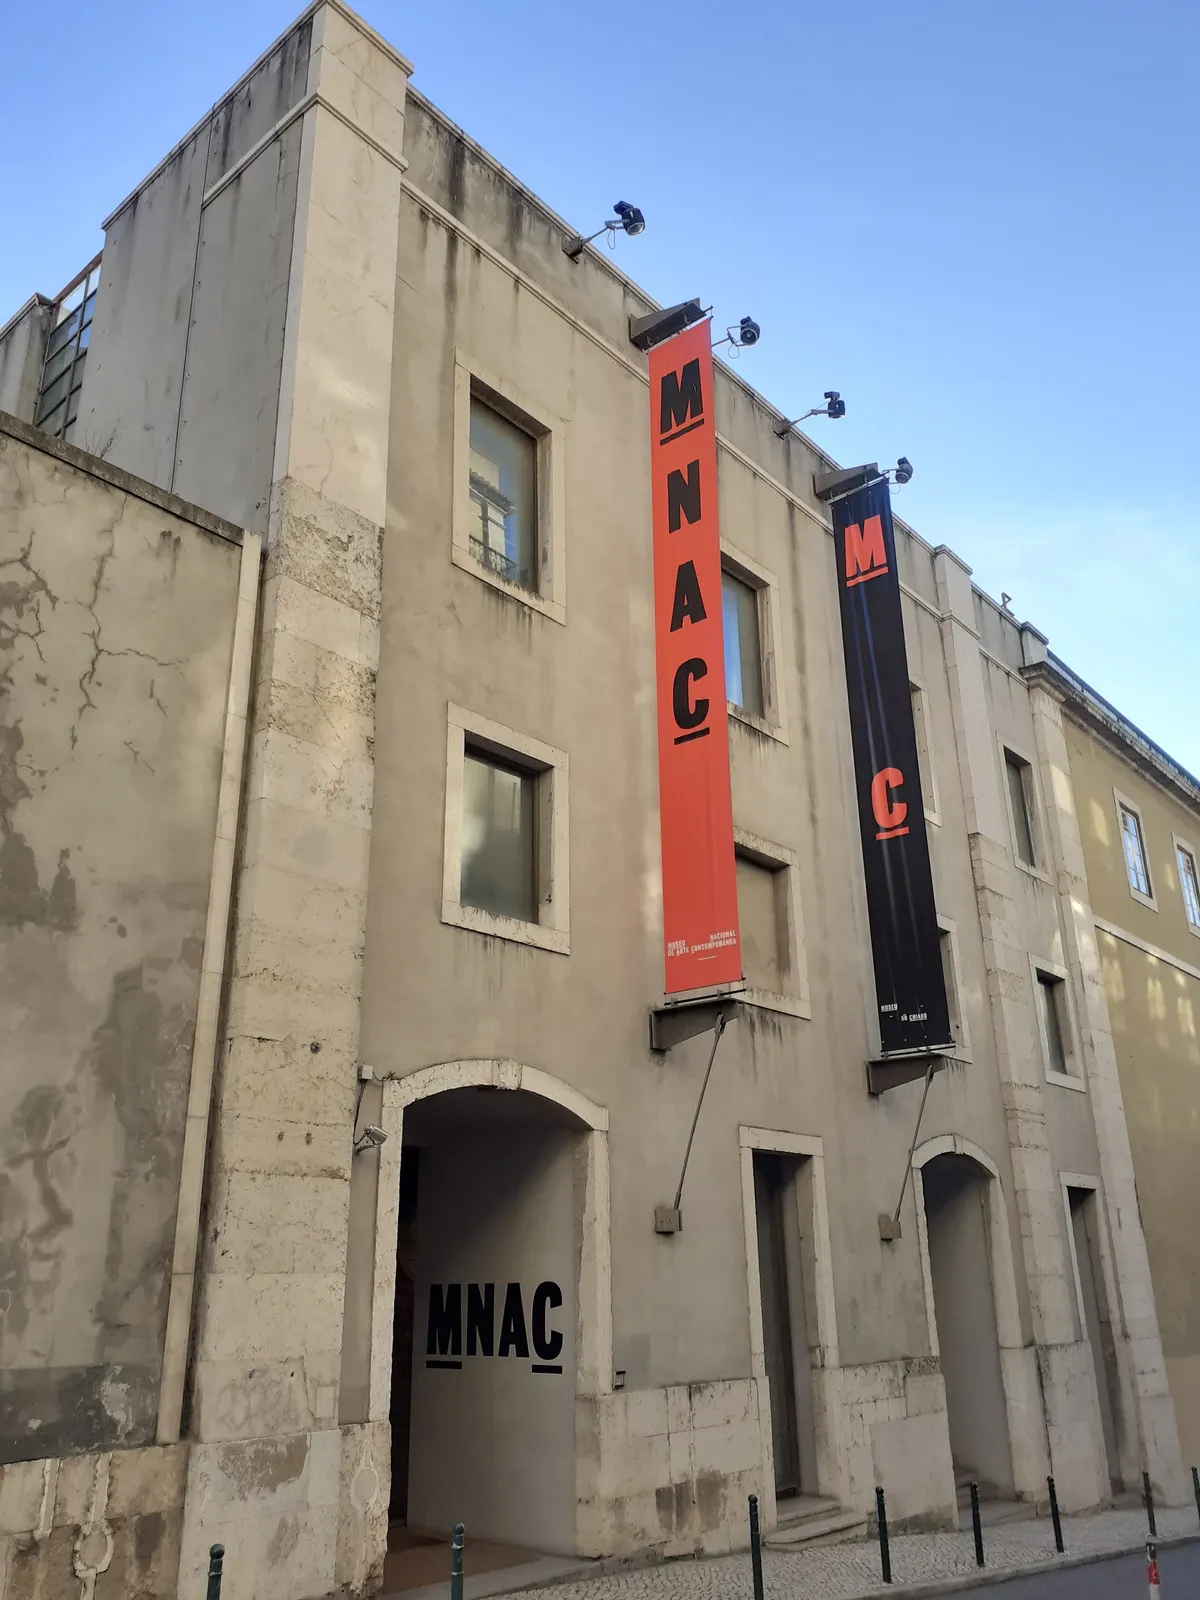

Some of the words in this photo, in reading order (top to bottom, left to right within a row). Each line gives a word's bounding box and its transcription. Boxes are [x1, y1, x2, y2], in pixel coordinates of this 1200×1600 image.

[660, 357, 709, 731] MNAC
[668, 940, 686, 949] MUSEU
[710, 930, 736, 941] NACIONAL
[676, 946, 689, 956] ARTE
[880, 1003, 898, 1012] MUSEU
[909, 1012, 928, 1021] CHIADO
[426, 1281, 564, 1361] MNAC
